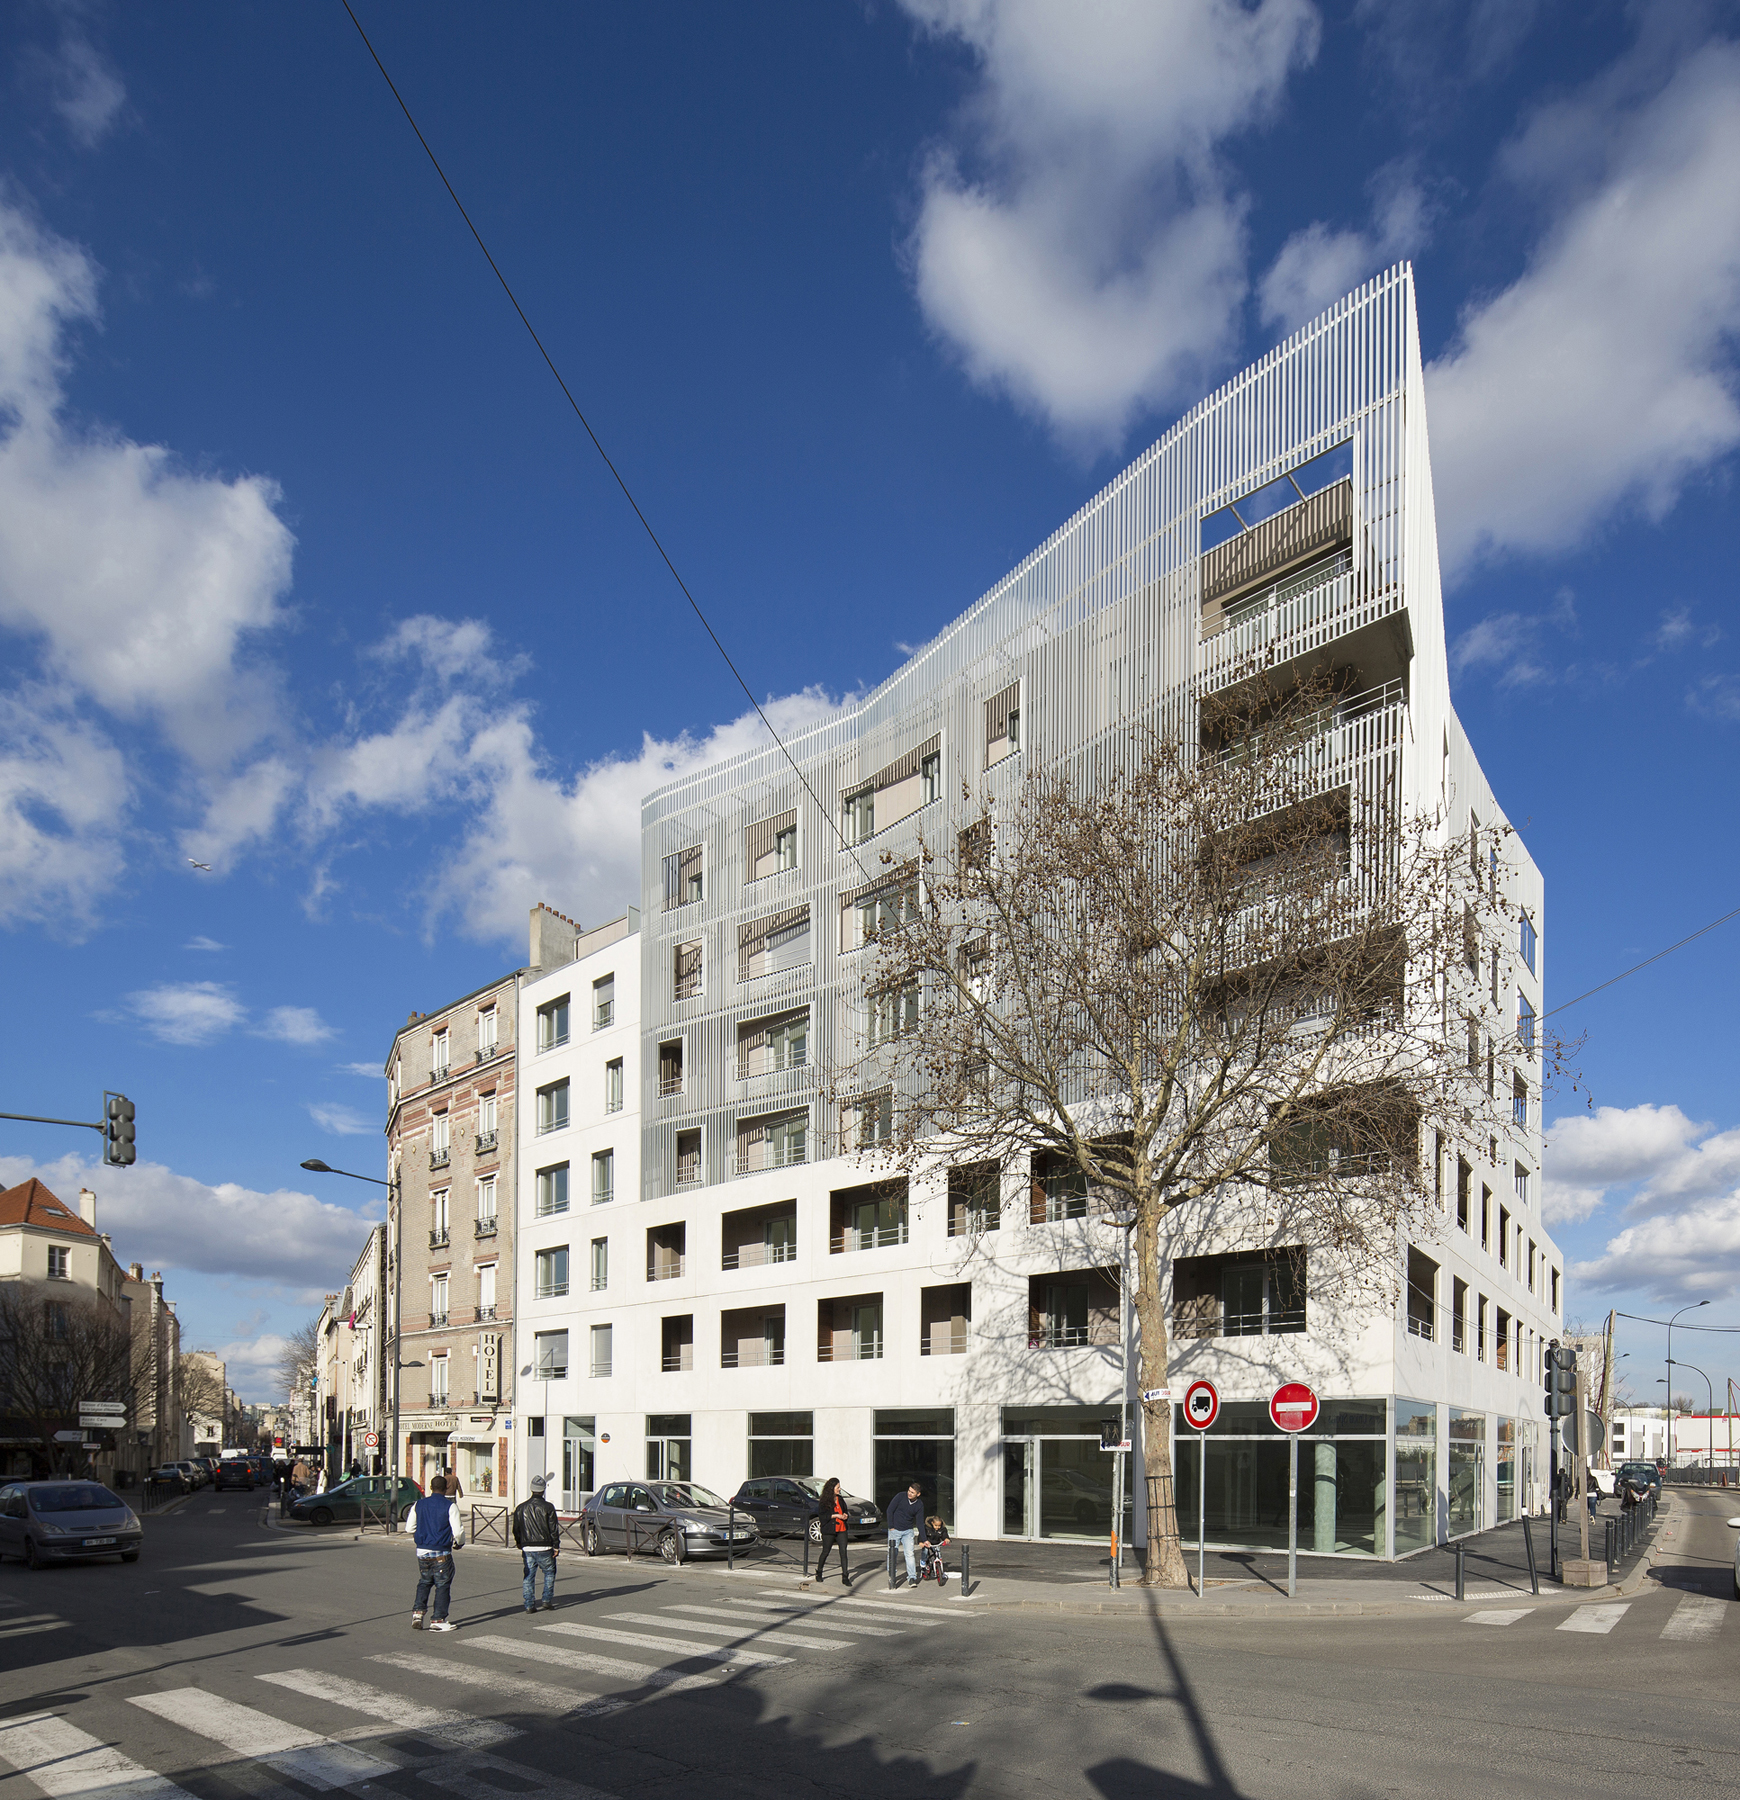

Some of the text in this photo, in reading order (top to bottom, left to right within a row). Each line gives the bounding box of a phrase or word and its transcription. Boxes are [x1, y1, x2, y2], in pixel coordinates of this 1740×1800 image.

[483, 1334, 496, 1392] HOTEL
[411, 1421, 434, 1430] MODERNE
[434, 1420, 458, 1428] HOTEL
